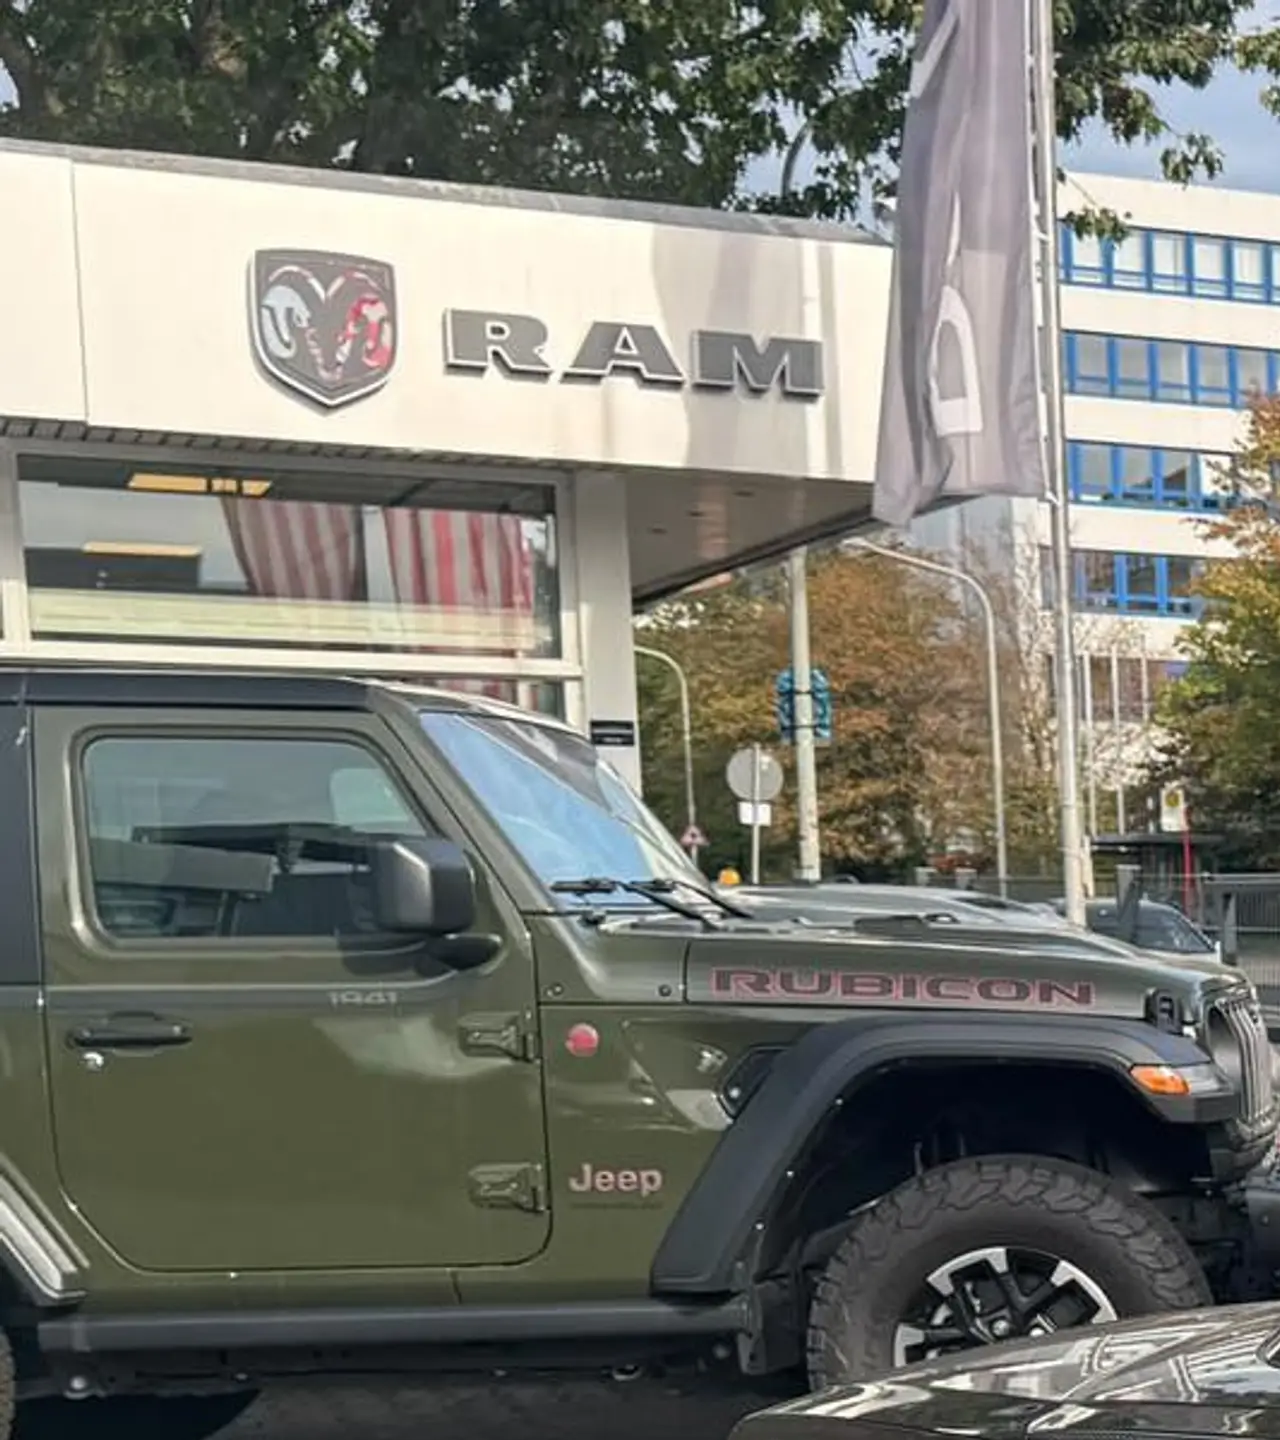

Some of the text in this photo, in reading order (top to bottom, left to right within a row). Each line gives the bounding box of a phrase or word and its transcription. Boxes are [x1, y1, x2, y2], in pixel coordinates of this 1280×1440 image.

[444, 308, 824, 401] RAM
[709, 967, 1096, 1006] RUBICON
[568, 1162, 663, 1199] Jeep
